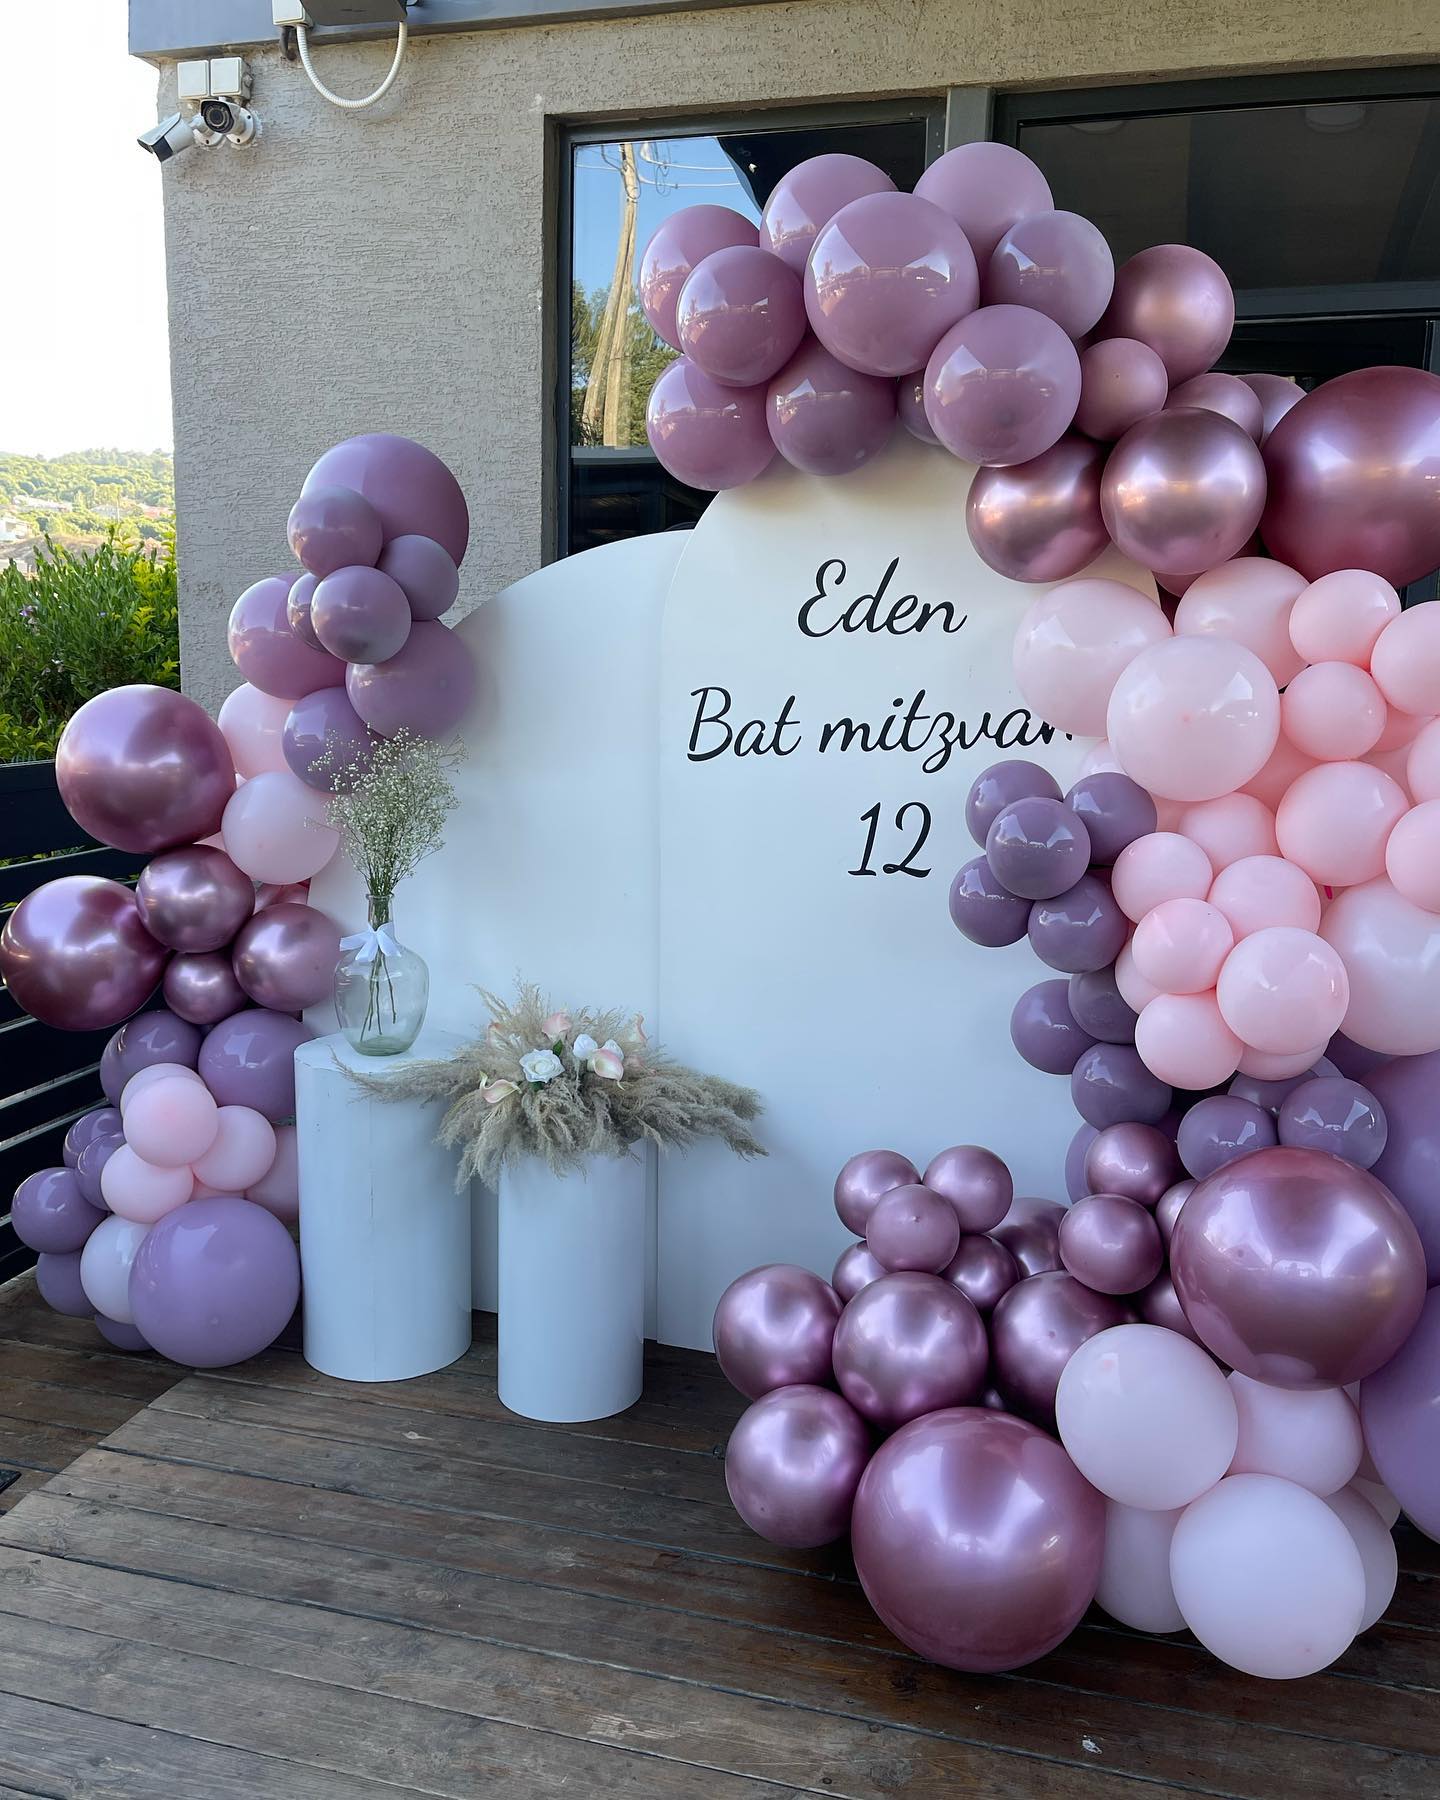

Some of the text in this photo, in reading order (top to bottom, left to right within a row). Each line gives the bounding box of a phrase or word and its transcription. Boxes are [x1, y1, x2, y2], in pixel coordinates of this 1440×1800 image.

[797, 556, 968, 638] Eden
[686, 686, 1073, 774] Bat mitzva
[847, 801, 932, 879] 12
